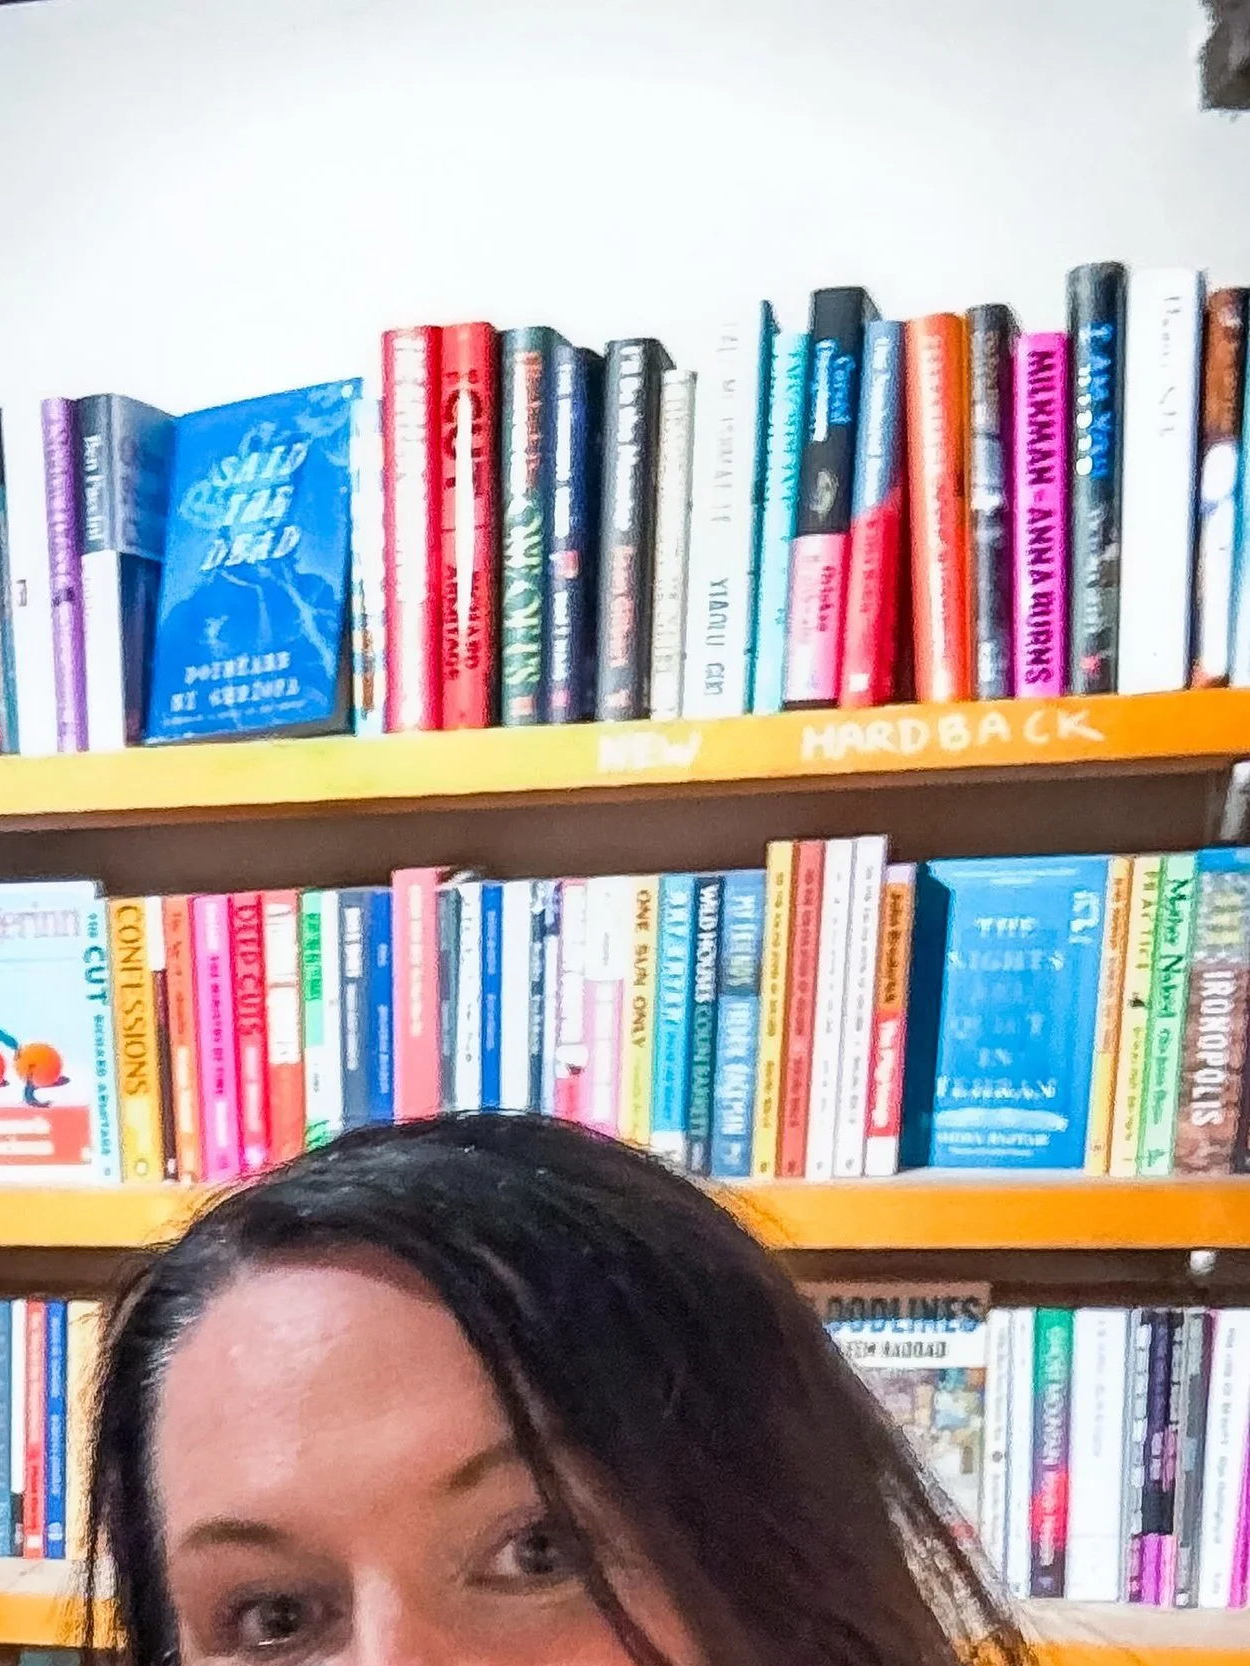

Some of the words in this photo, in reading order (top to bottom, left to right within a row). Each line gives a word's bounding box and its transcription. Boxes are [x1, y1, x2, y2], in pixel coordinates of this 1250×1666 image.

[1026, 350, 1055, 485] MILKMAN
[212, 442, 307, 488] SAID
[223, 484, 295, 527] THE
[200, 525, 301, 571] DEAD
[1028, 509, 1053, 585] ANNA
[635, 889, 652, 933] ONE
[698, 884, 721, 932] WILD
[1165, 878, 1193, 947] Mother
[83, 945, 110, 1006] CUT
[634, 943, 652, 986] SUN
[1156, 953, 1186, 1019] Naked
[115, 905, 150, 1097] CONFESSIONS
[630, 996, 648, 1049] ONLY
[1190, 970, 1237, 1127] IRONOPOLIS
[826, 1296, 981, 1333] OODLINES
